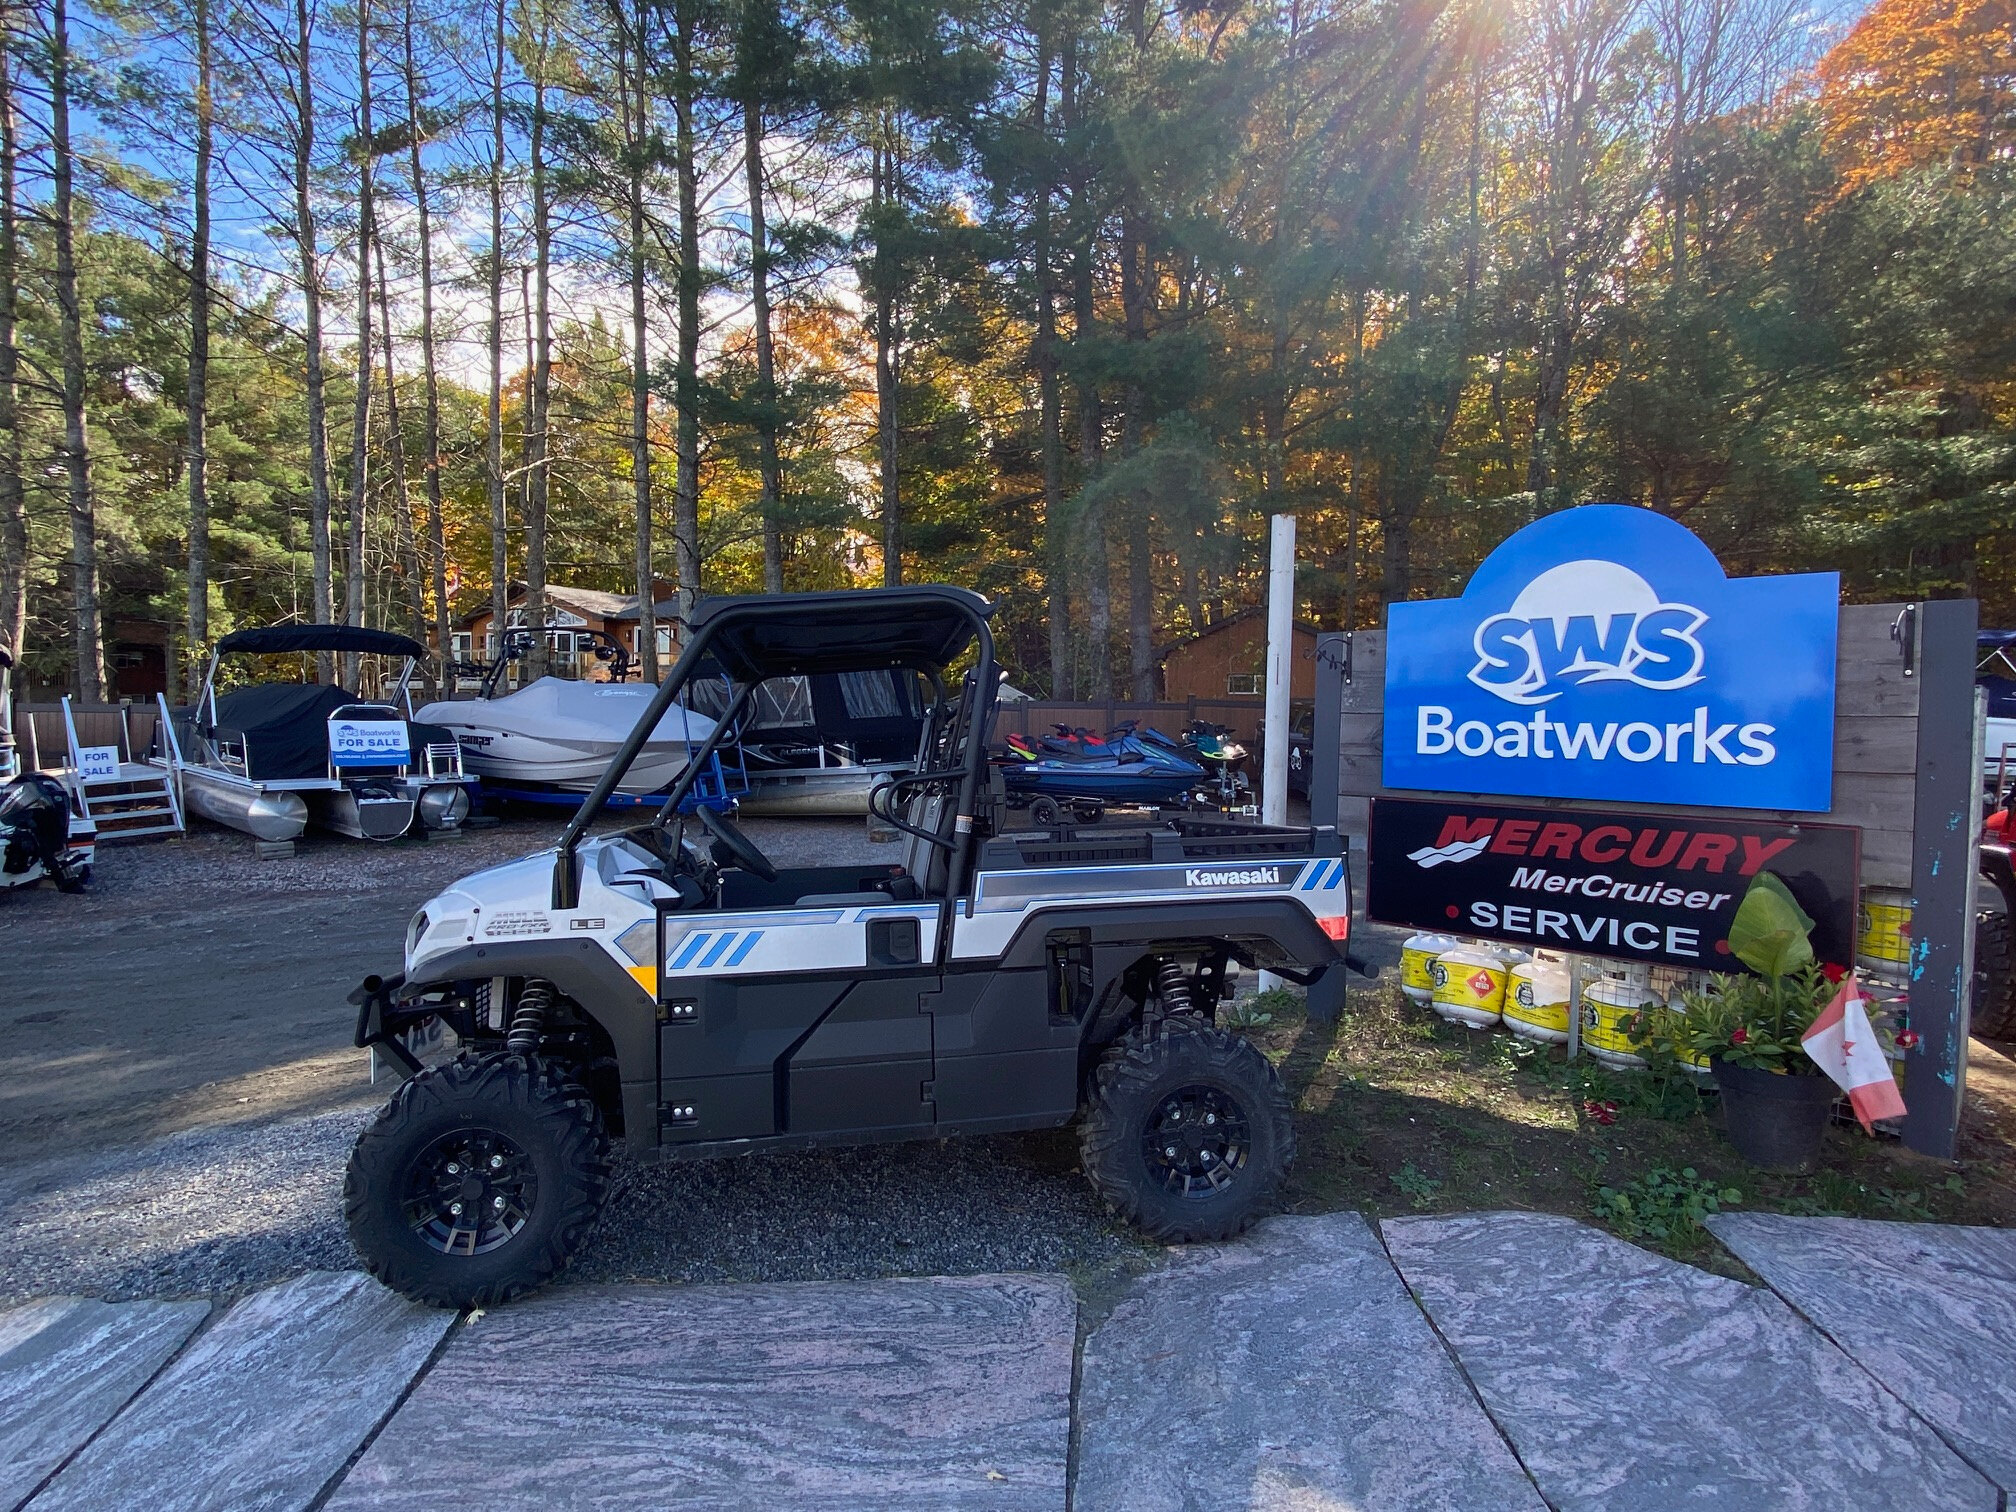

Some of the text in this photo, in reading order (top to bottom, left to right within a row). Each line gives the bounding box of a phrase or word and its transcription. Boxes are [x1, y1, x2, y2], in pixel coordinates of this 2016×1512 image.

[1467, 602, 1711, 705] SWS
[338, 738, 401, 747] FOR SALE
[360, 729, 401, 737] Boatworks
[1416, 705, 1776, 767] Boatworks
[85, 752, 109, 761] FOR
[84, 766, 114, 776] SALE
[1435, 815, 1797, 876] MERCURY
[1185, 866, 1280, 887] Kawasaki
[1509, 866, 1732, 910] MerCruiser
[569, 918, 606, 931] LE
[1469, 901, 1701, 957] SERVICE
